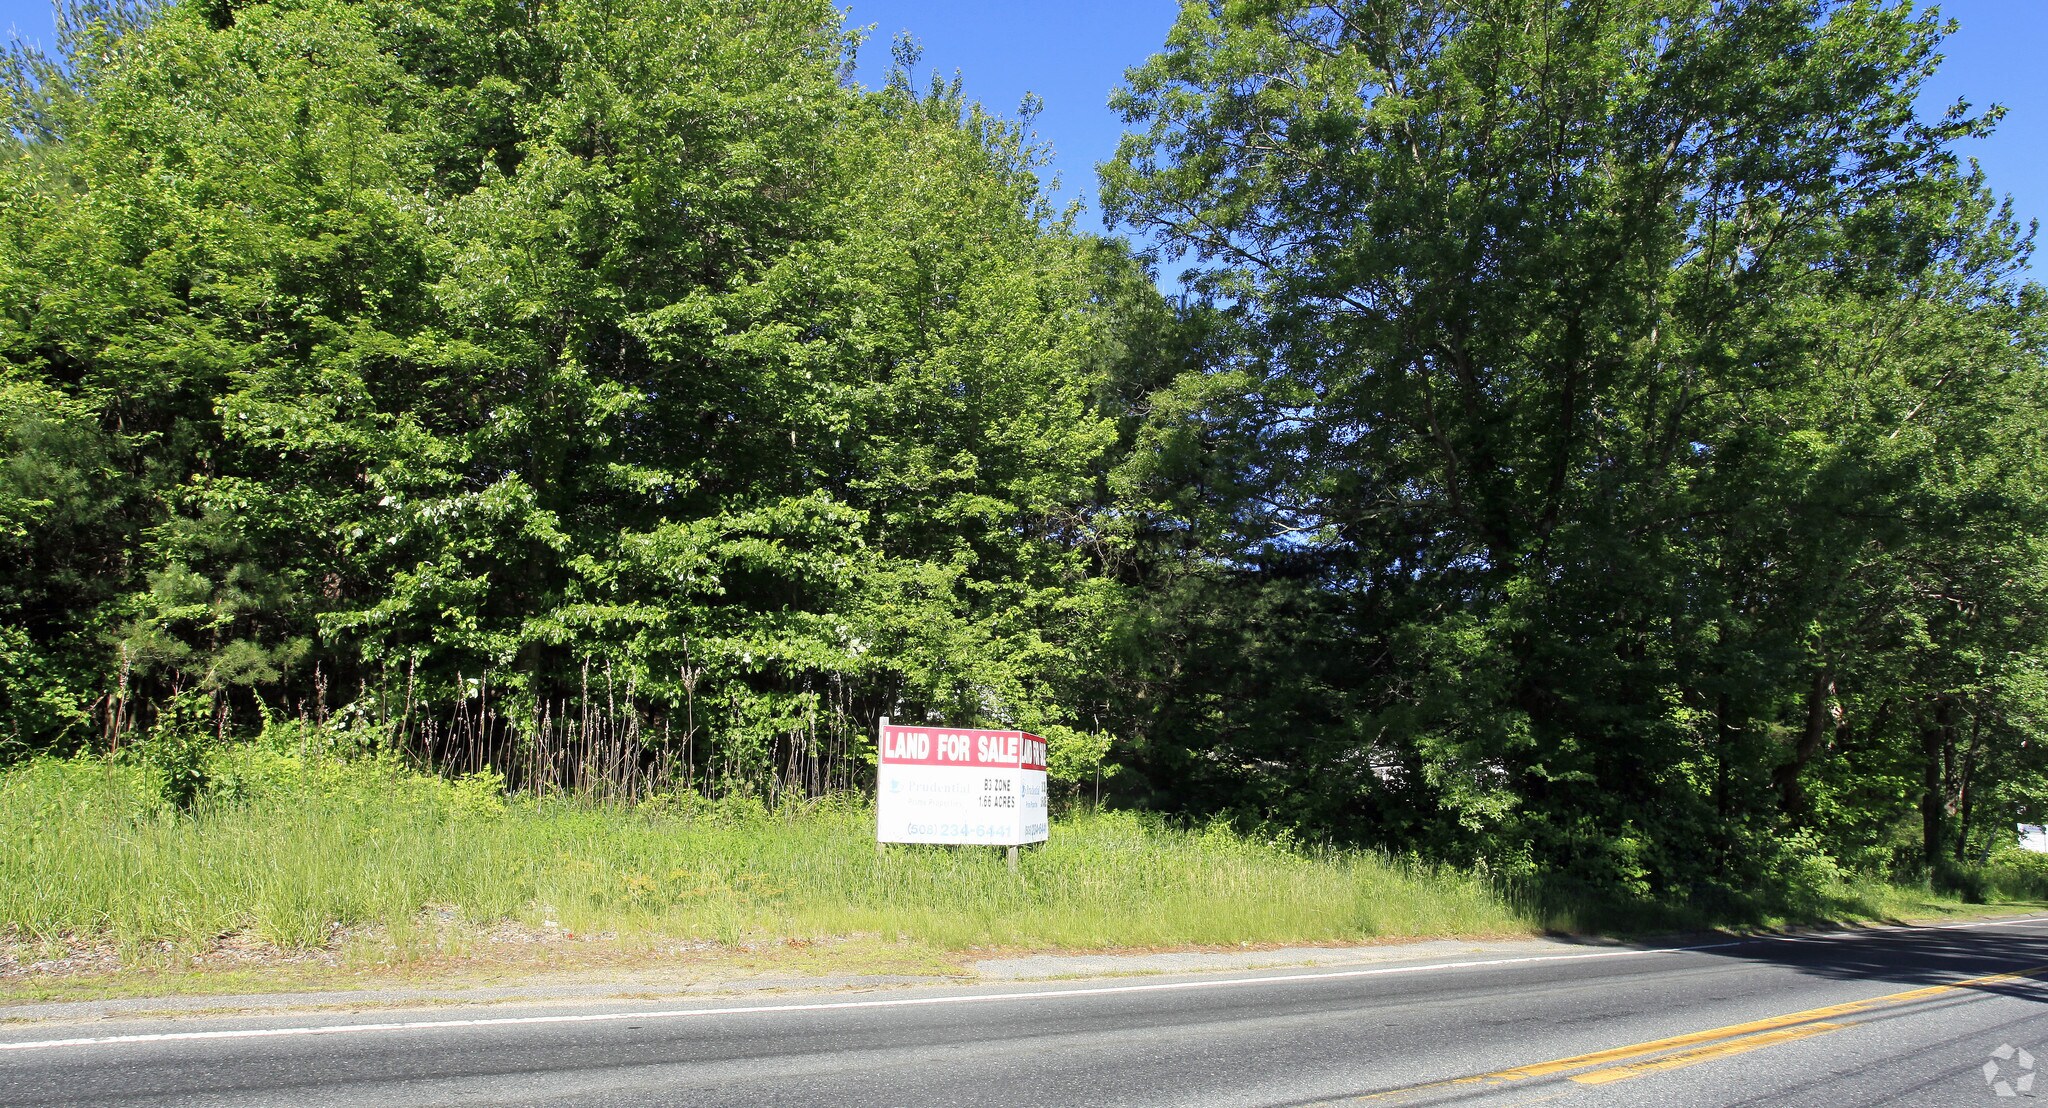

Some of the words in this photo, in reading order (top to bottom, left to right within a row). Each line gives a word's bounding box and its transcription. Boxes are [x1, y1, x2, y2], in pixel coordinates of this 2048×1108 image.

[885, 732, 930, 760] LAND
[937, 734, 970, 762] FOR
[977, 736, 1019, 764] SALE
[908, 780, 970, 793] Prudential
[984, 778, 992, 791] B3
[995, 778, 1011, 791] ZONE
[979, 796, 992, 808] 1.66
[994, 796, 1015, 809] ACRES
